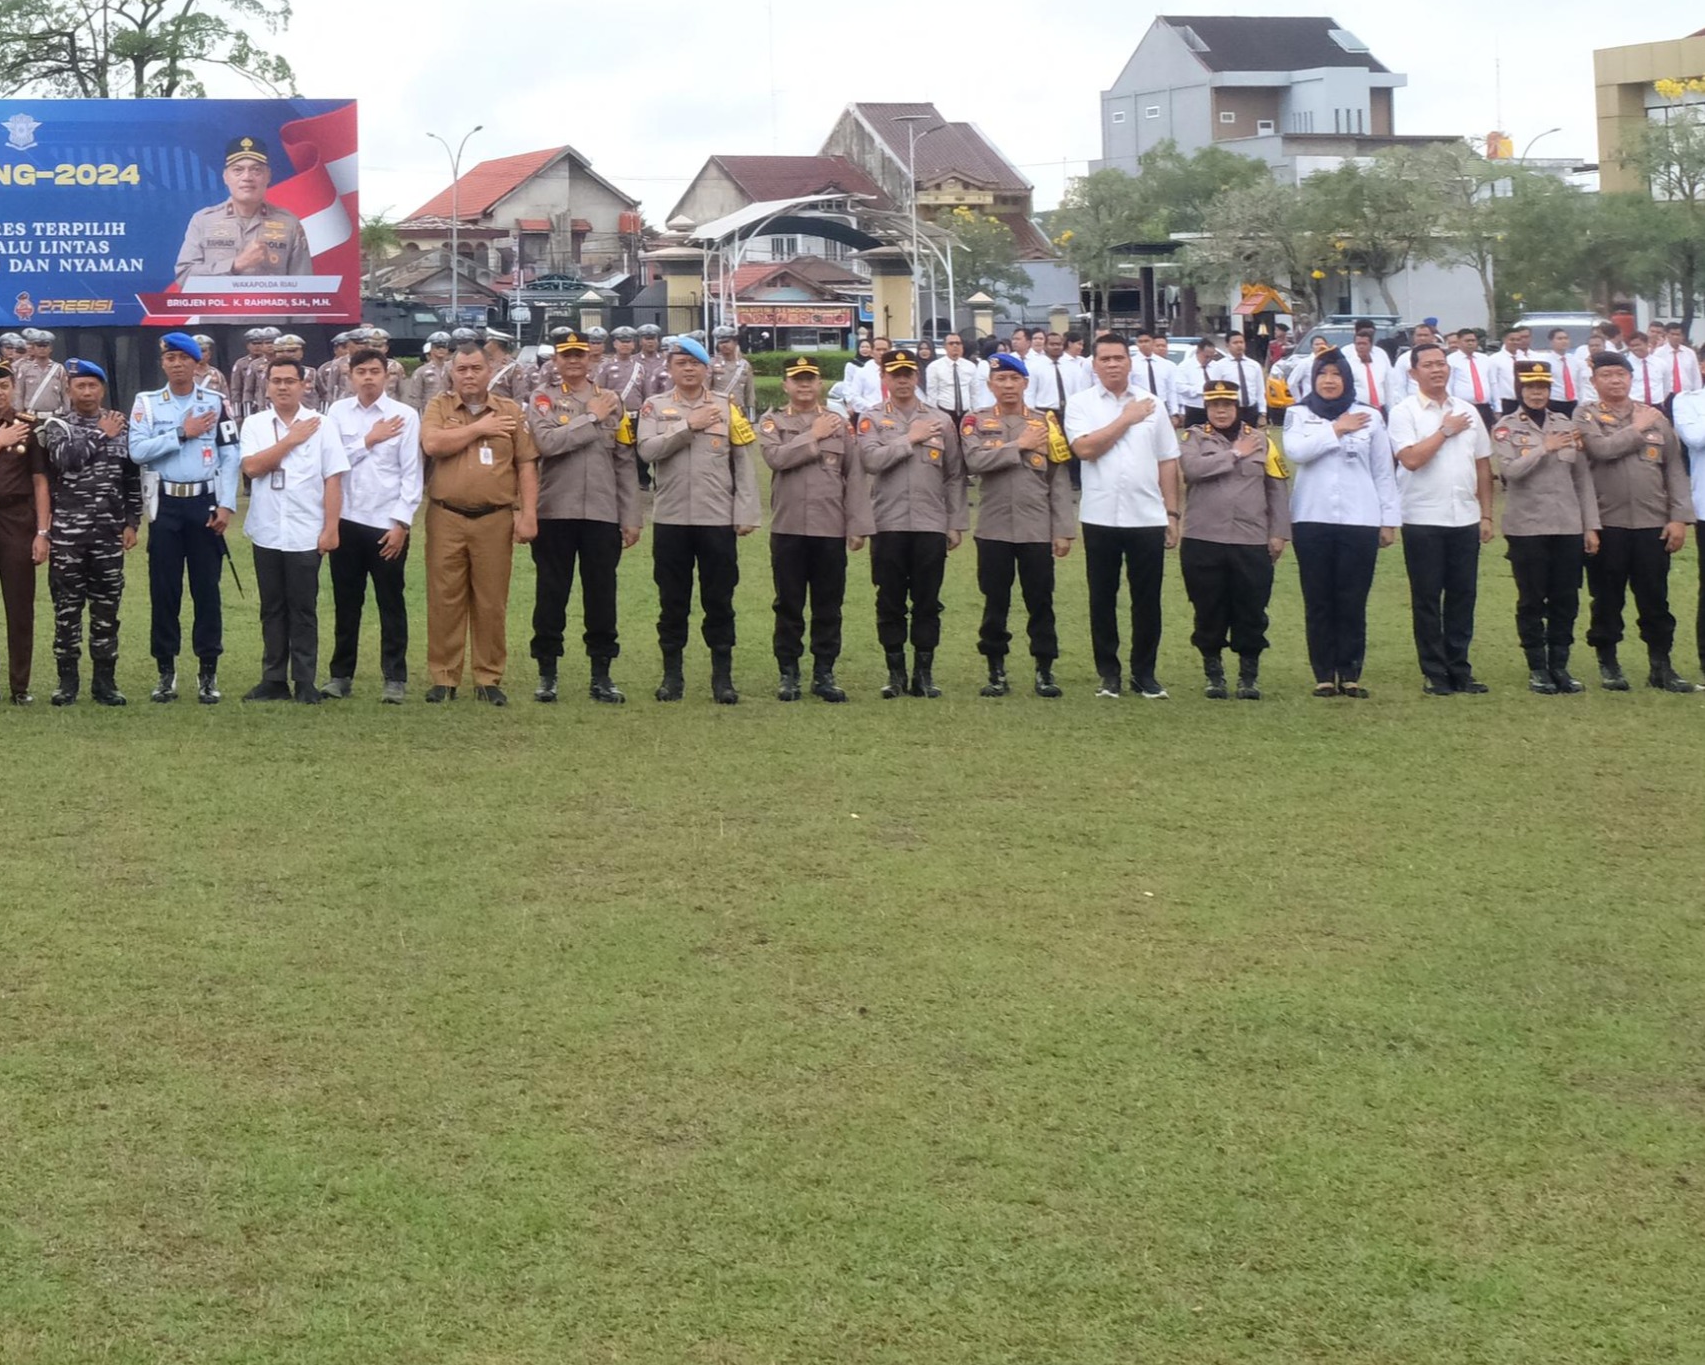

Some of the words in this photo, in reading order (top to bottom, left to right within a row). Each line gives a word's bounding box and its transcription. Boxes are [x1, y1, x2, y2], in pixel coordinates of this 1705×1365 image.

[32, 222, 126, 236] TERPILIH
[39, 240, 110, 255] LINTAS
[9, 258, 50, 273] DAN
[59, 258, 144, 272] NYAMAN
[231, 280, 279, 289] WAKAPOLDA
[280, 280, 299, 288] RIAU
[38, 299, 114, 313] PRESISI
[166, 298, 206, 307] BRIGJEN
[244, 298, 290, 308] RAHMADI,
